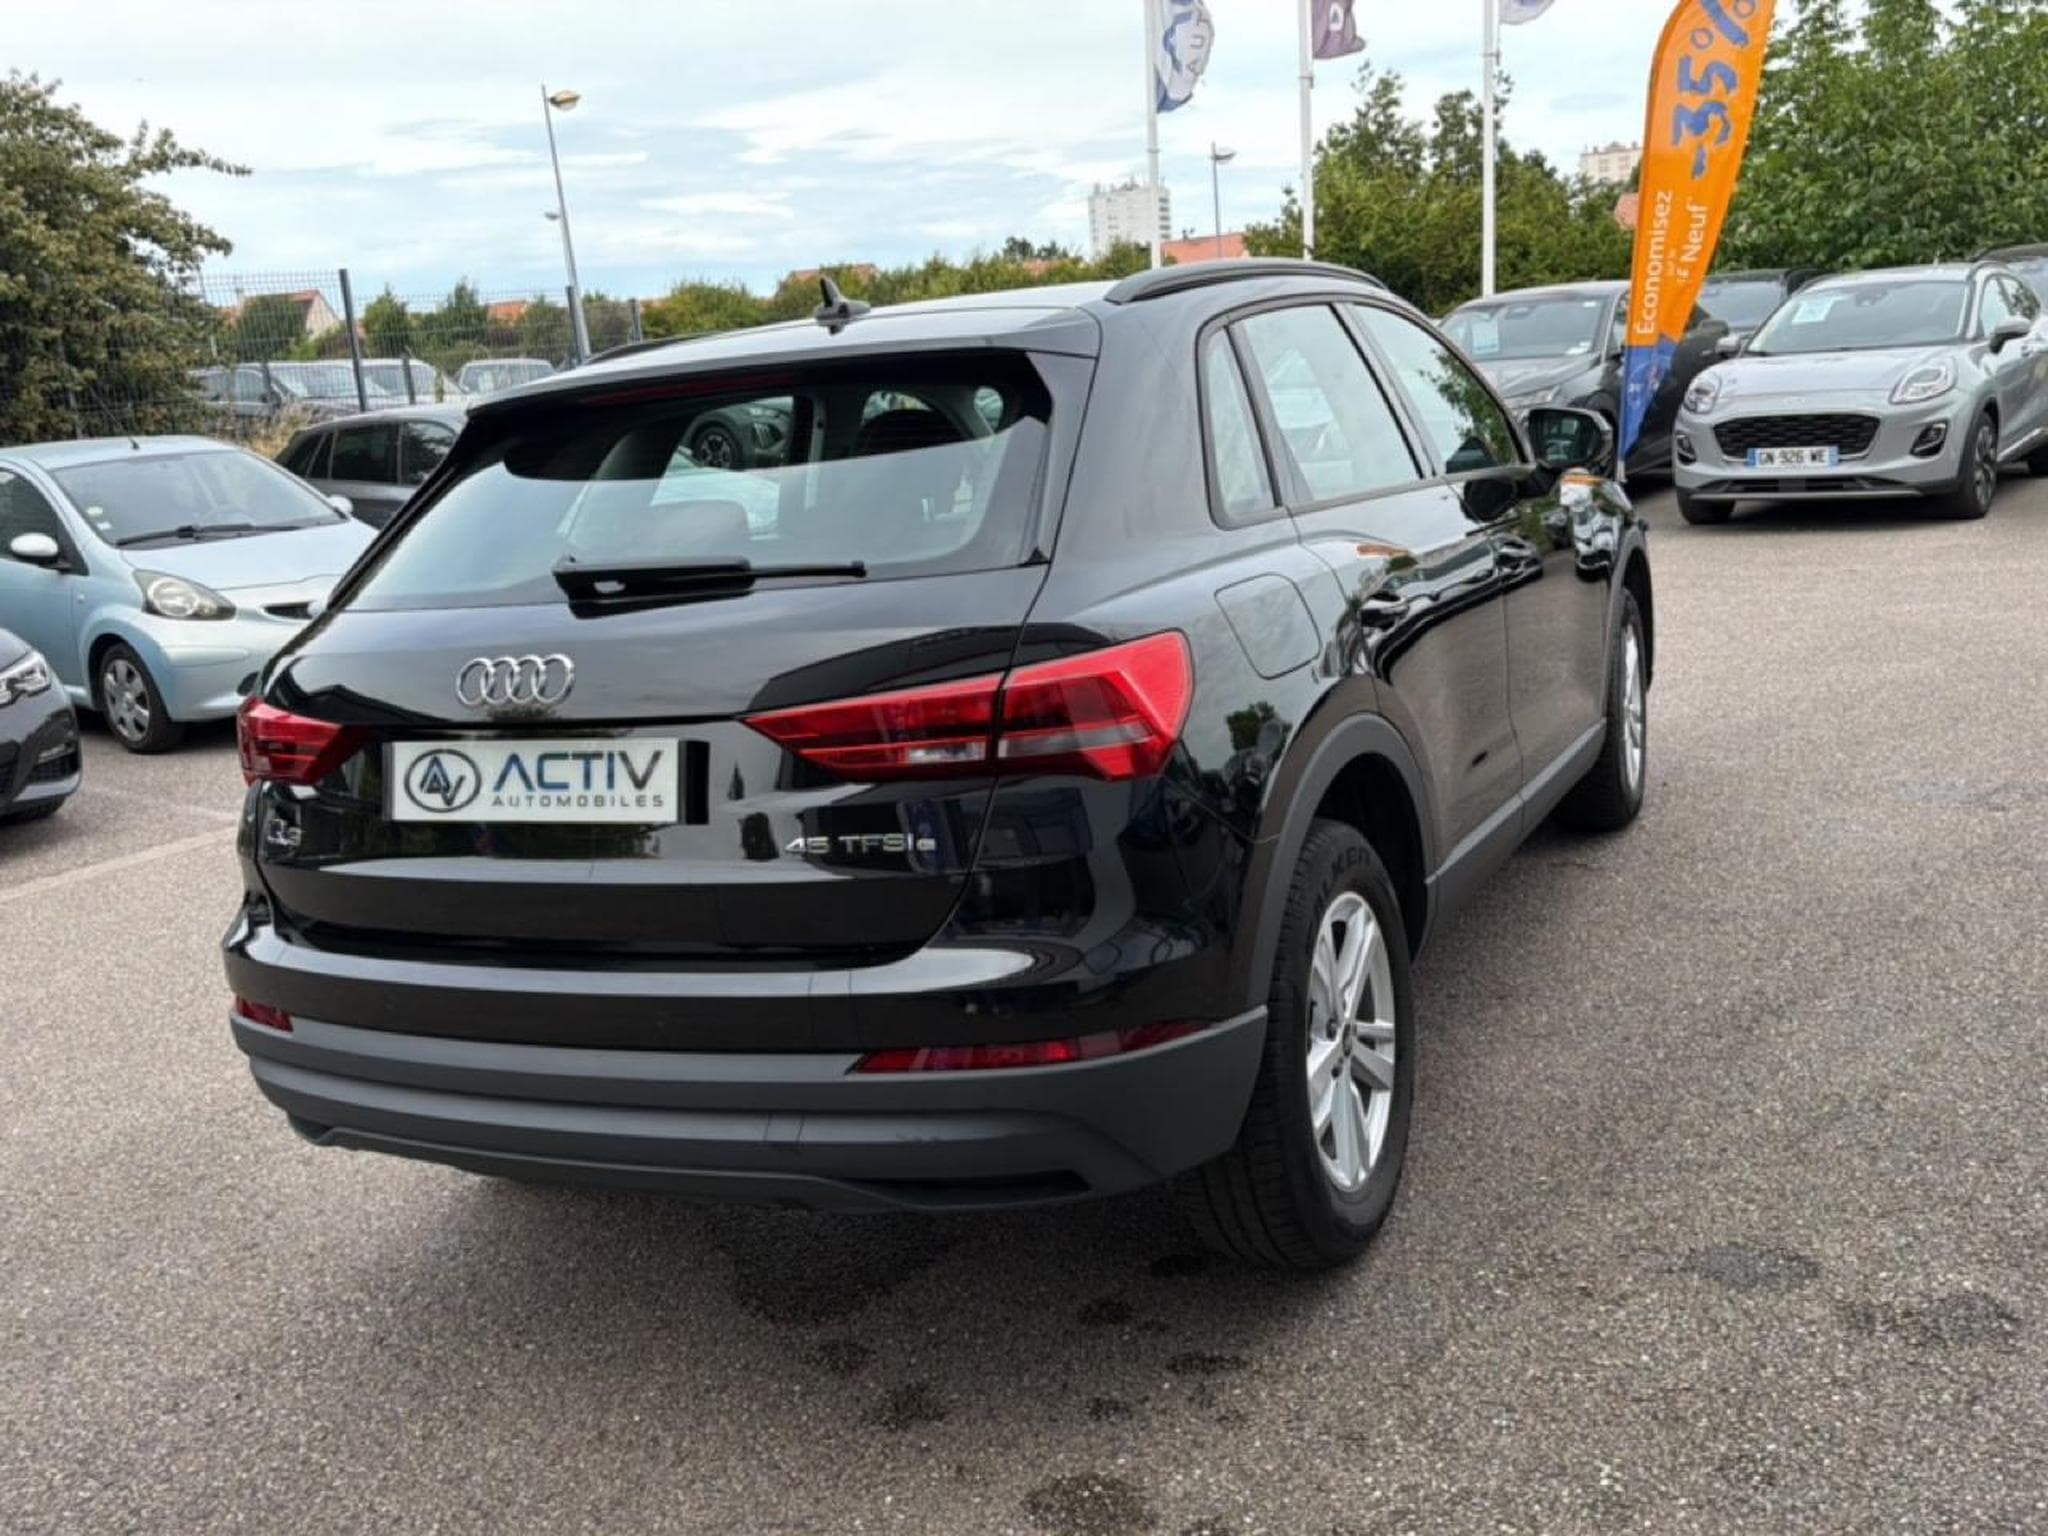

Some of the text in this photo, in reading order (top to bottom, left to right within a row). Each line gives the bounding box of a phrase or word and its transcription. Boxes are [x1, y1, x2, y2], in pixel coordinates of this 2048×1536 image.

[1680, 196, 1708, 262] Neuf
[1634, 190, 1673, 334] Économisez
[493, 750, 664, 792] ACTIV
[491, 794, 664, 808] AUTOMOBILES
[785, 835, 830, 854] 45
